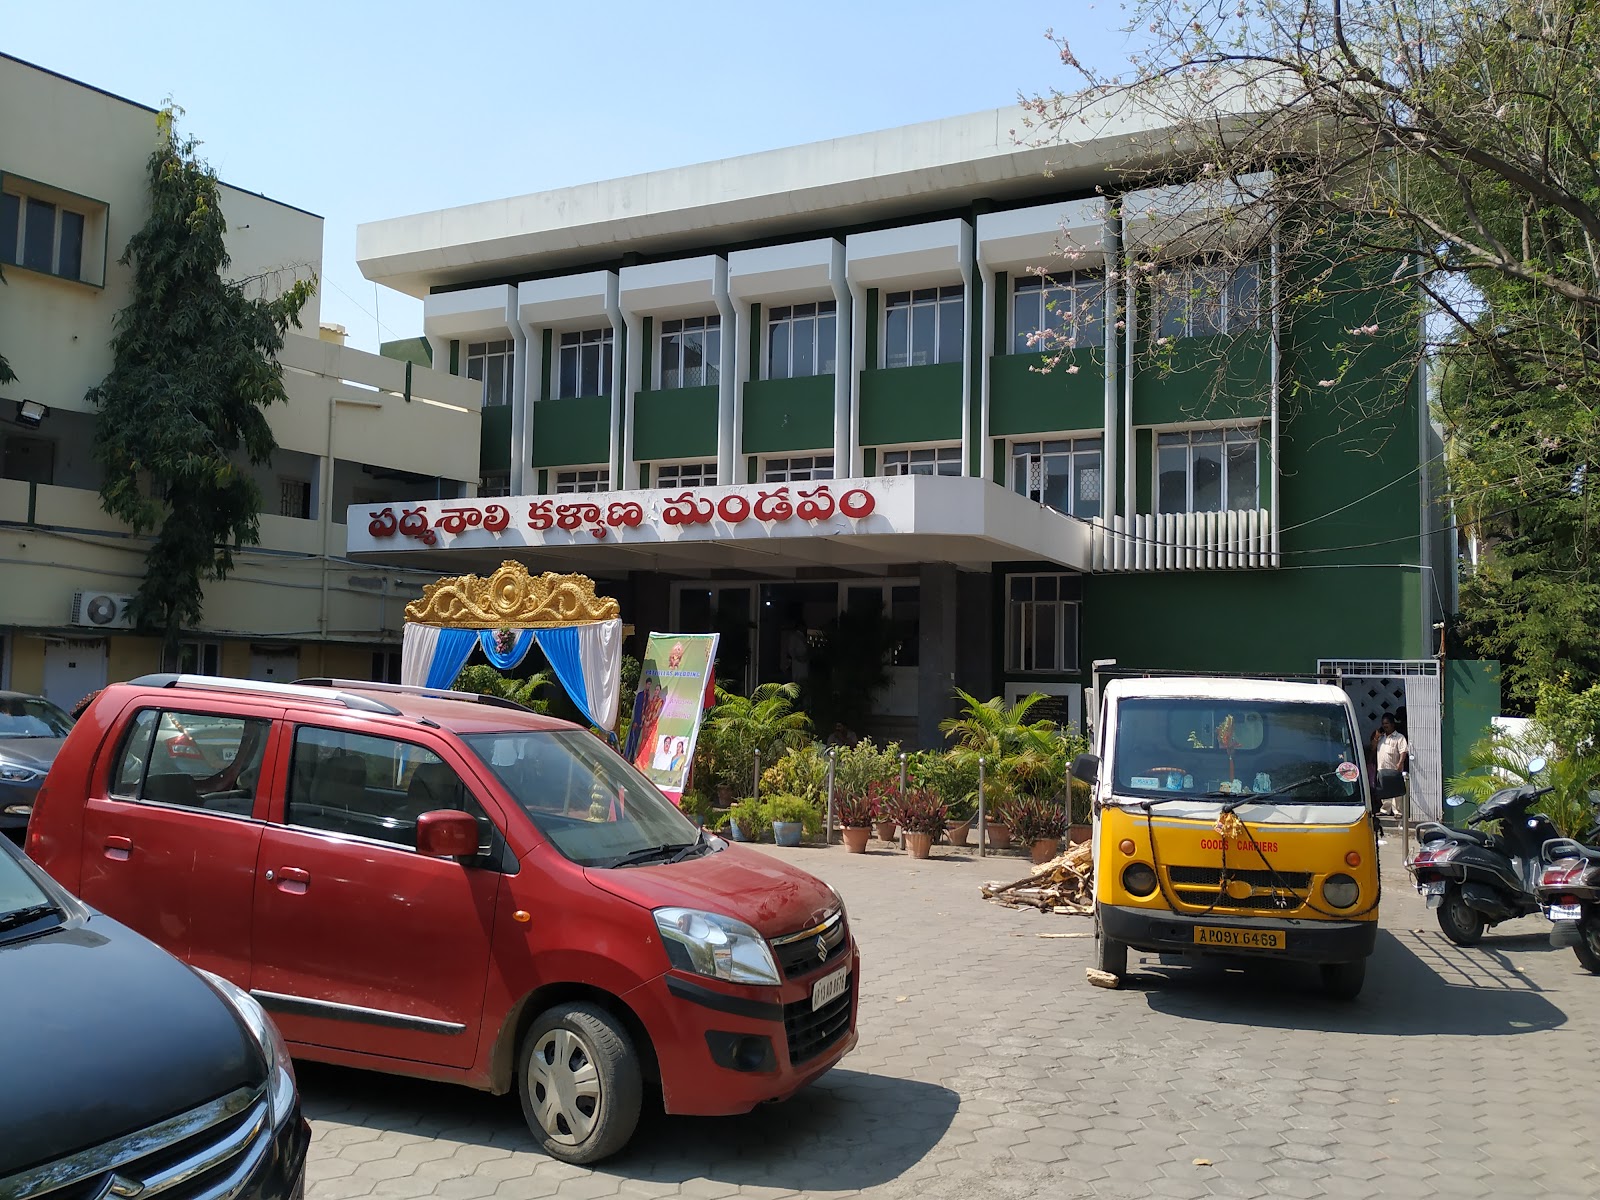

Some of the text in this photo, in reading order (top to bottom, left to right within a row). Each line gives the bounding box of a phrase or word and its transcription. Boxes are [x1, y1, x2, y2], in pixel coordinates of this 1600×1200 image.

[368, 485, 876, 546] పద్మశాలి కళ్యాణ మండపం
[1200, 838, 1229, 851] GOODS
